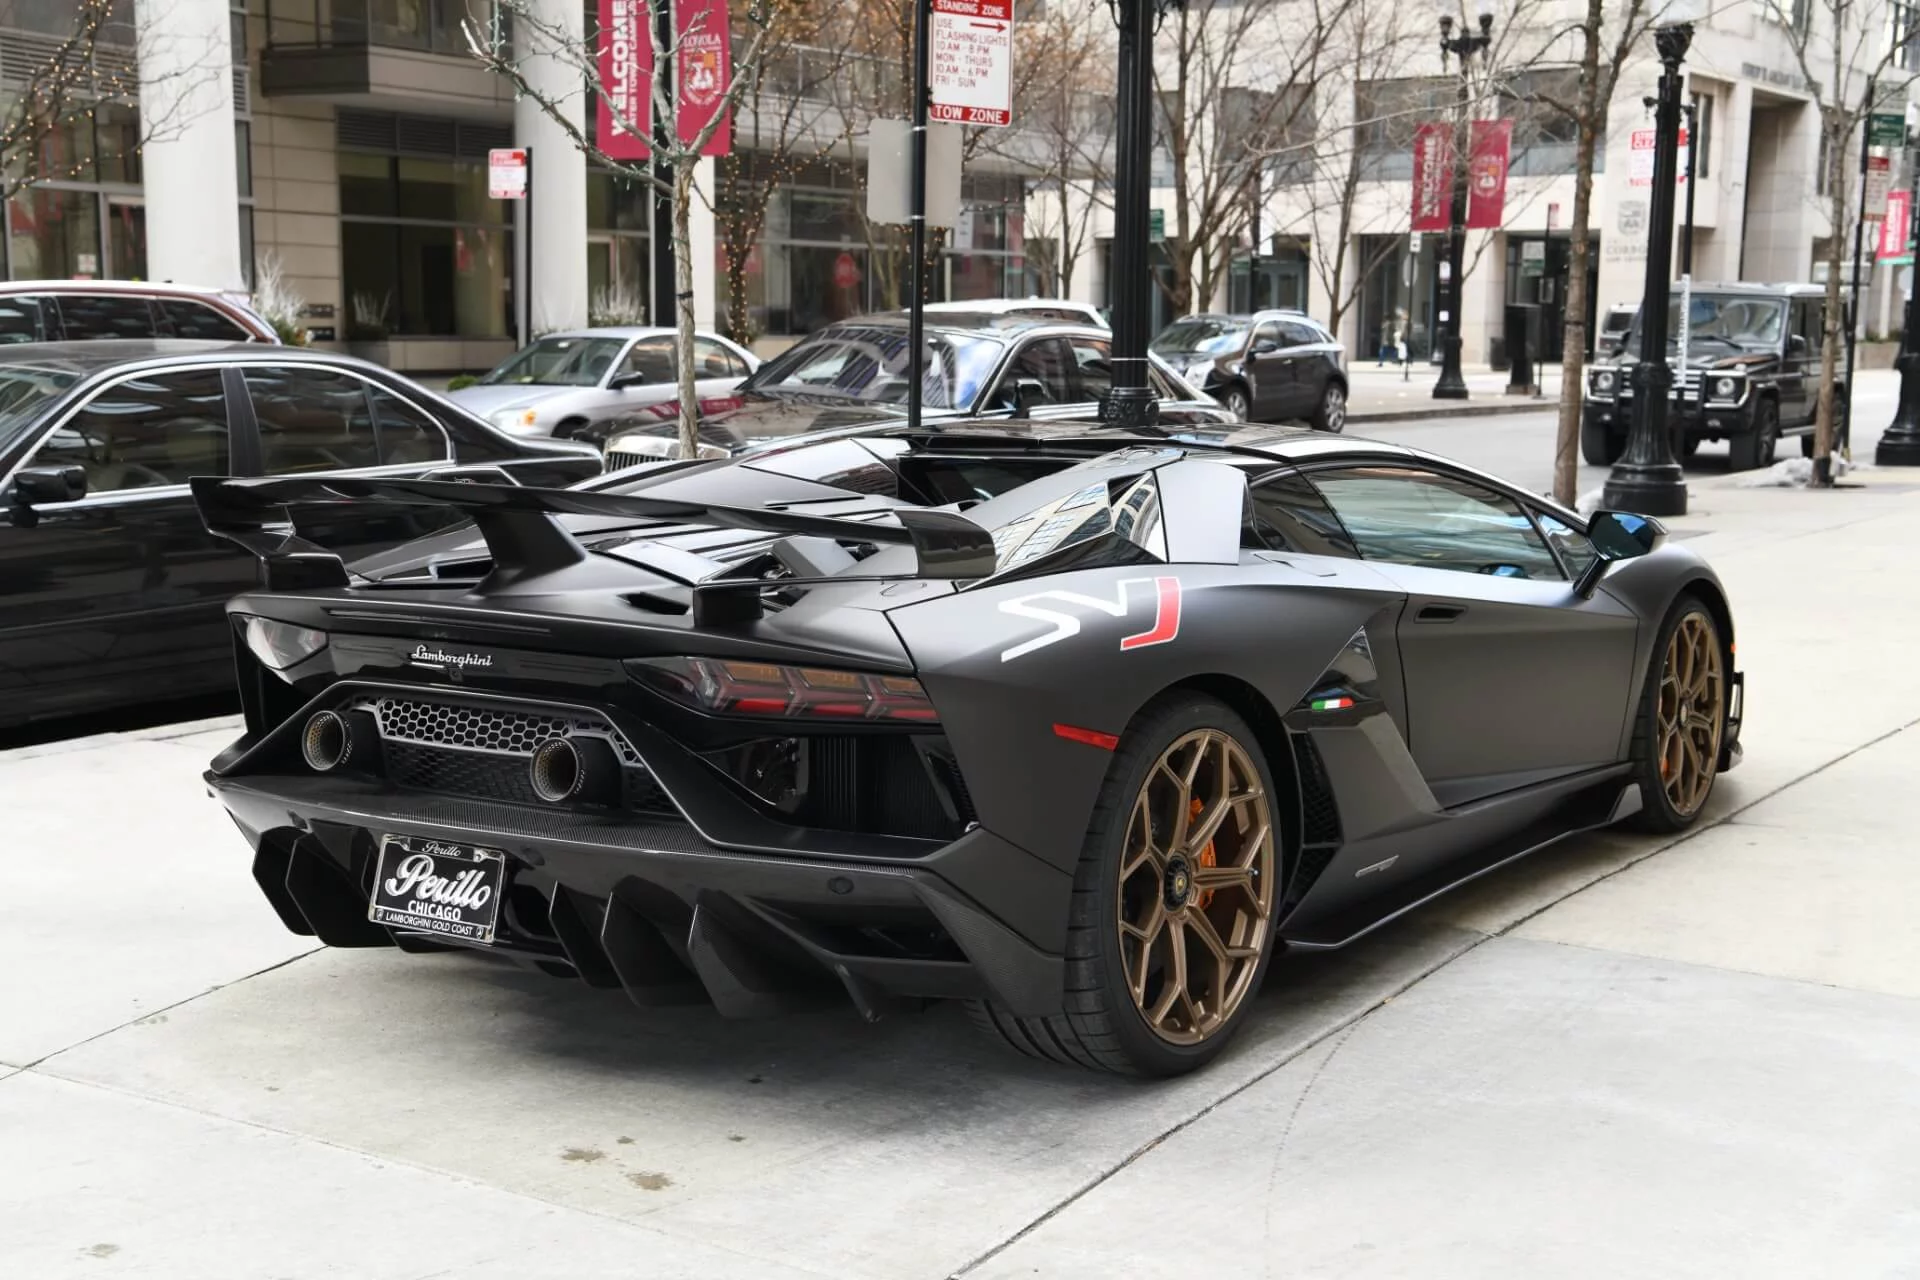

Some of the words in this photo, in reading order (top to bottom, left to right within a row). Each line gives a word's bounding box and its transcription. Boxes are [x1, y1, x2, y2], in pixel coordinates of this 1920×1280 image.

[936, 0, 978, 14] STANDING
[982, 4, 1005, 17] ZONE
[936, 18, 953, 29] USE
[936, 29, 977, 43] FLASHING
[979, 34, 1008, 47] LIGHTS
[936, 41, 945, 50] 10
[947, 42, 960, 51] AM
[977, 45, 990, 54] PM
[611, 0, 629, 136] WELCOME
[936, 53, 955, 62] MON
[965, 55, 993, 67] THURS
[936, 64, 944, 73] 10
[946, 65, 959, 74] AM
[976, 68, 989, 78] PM
[936, 75, 950, 85] FRI
[958, 77, 977, 88] SUN
[935, 105, 963, 119] TOW
[969, 108, 1004, 123] ZONE
[411, 644, 493, 669] Lamborghini
[421, 840, 462, 857] Perillo
[385, 854, 491, 910] Perillo
[407, 900, 461, 920] CHICAGO
[386, 912, 431, 928] LAMBORGHINI
[431, 920, 450, 932] GOLD
[451, 926, 473, 936] COAST
